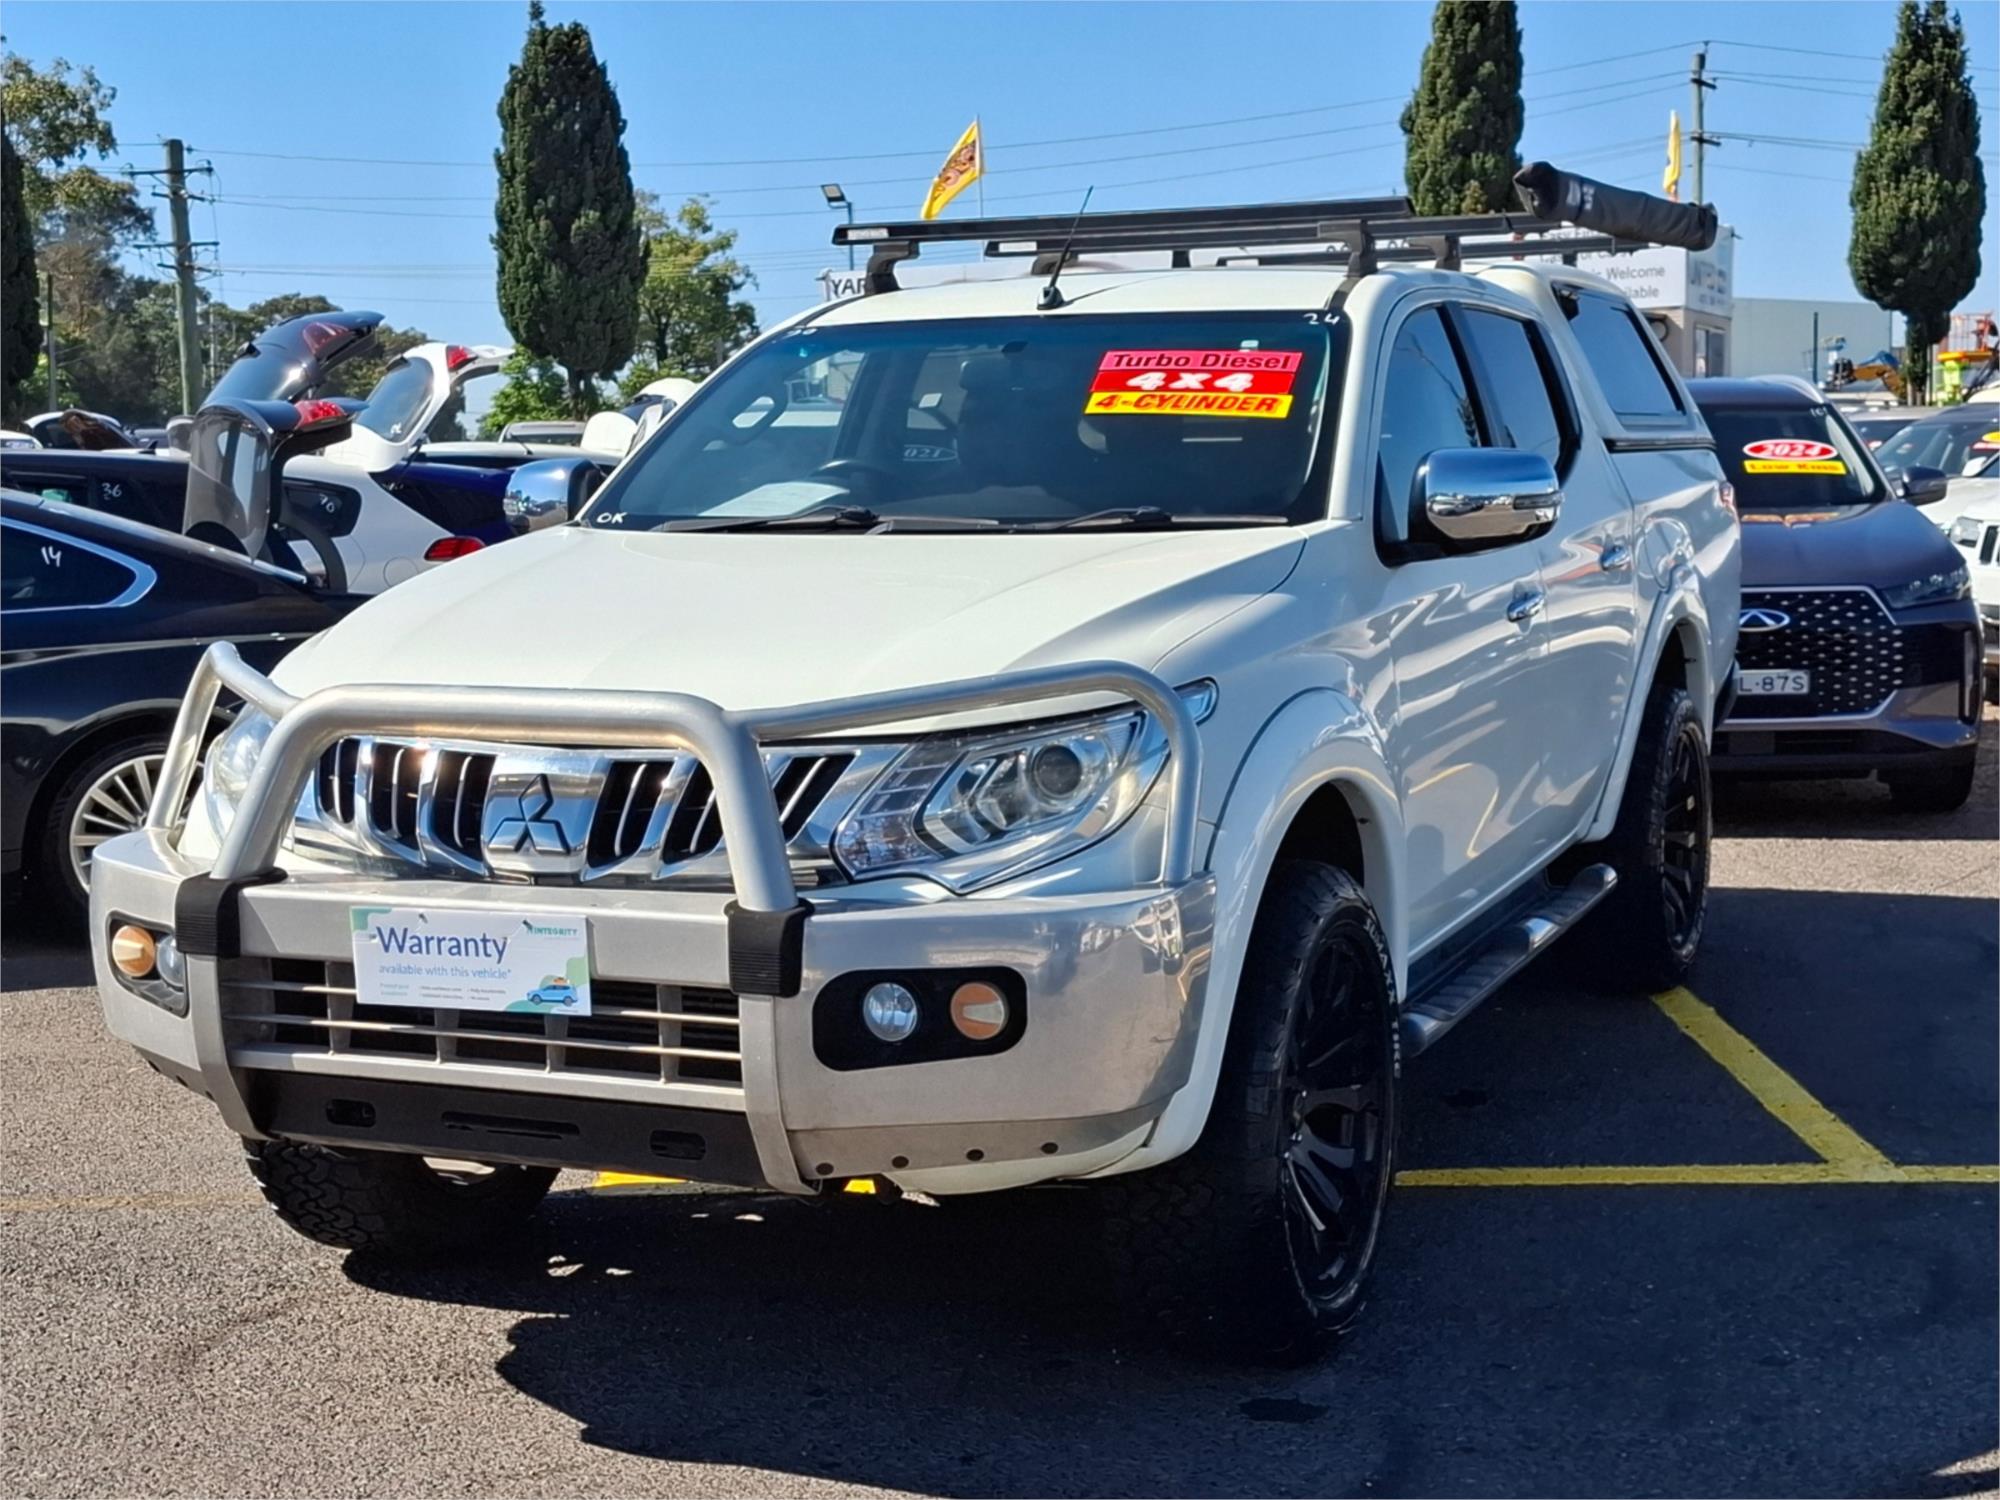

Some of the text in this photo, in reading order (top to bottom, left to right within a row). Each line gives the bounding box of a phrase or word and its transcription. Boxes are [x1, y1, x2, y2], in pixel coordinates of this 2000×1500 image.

[1606, 266, 1665, 280] Welcome
[1114, 354, 1290, 369] Turbo Diesel
[1096, 394, 1280, 412] 4-CYLINDER
[904, 448, 942, 458] 021
[1760, 443, 1821, 457] 2024
[596, 512, 628, 524] OK
[41, 546, 62, 567] 14
[533, 927, 578, 936] INTEGRITY
[376, 926, 508, 964] Warranty
[378, 963, 424, 976] available
[426, 966, 448, 977] with
[450, 966, 469, 977] this
